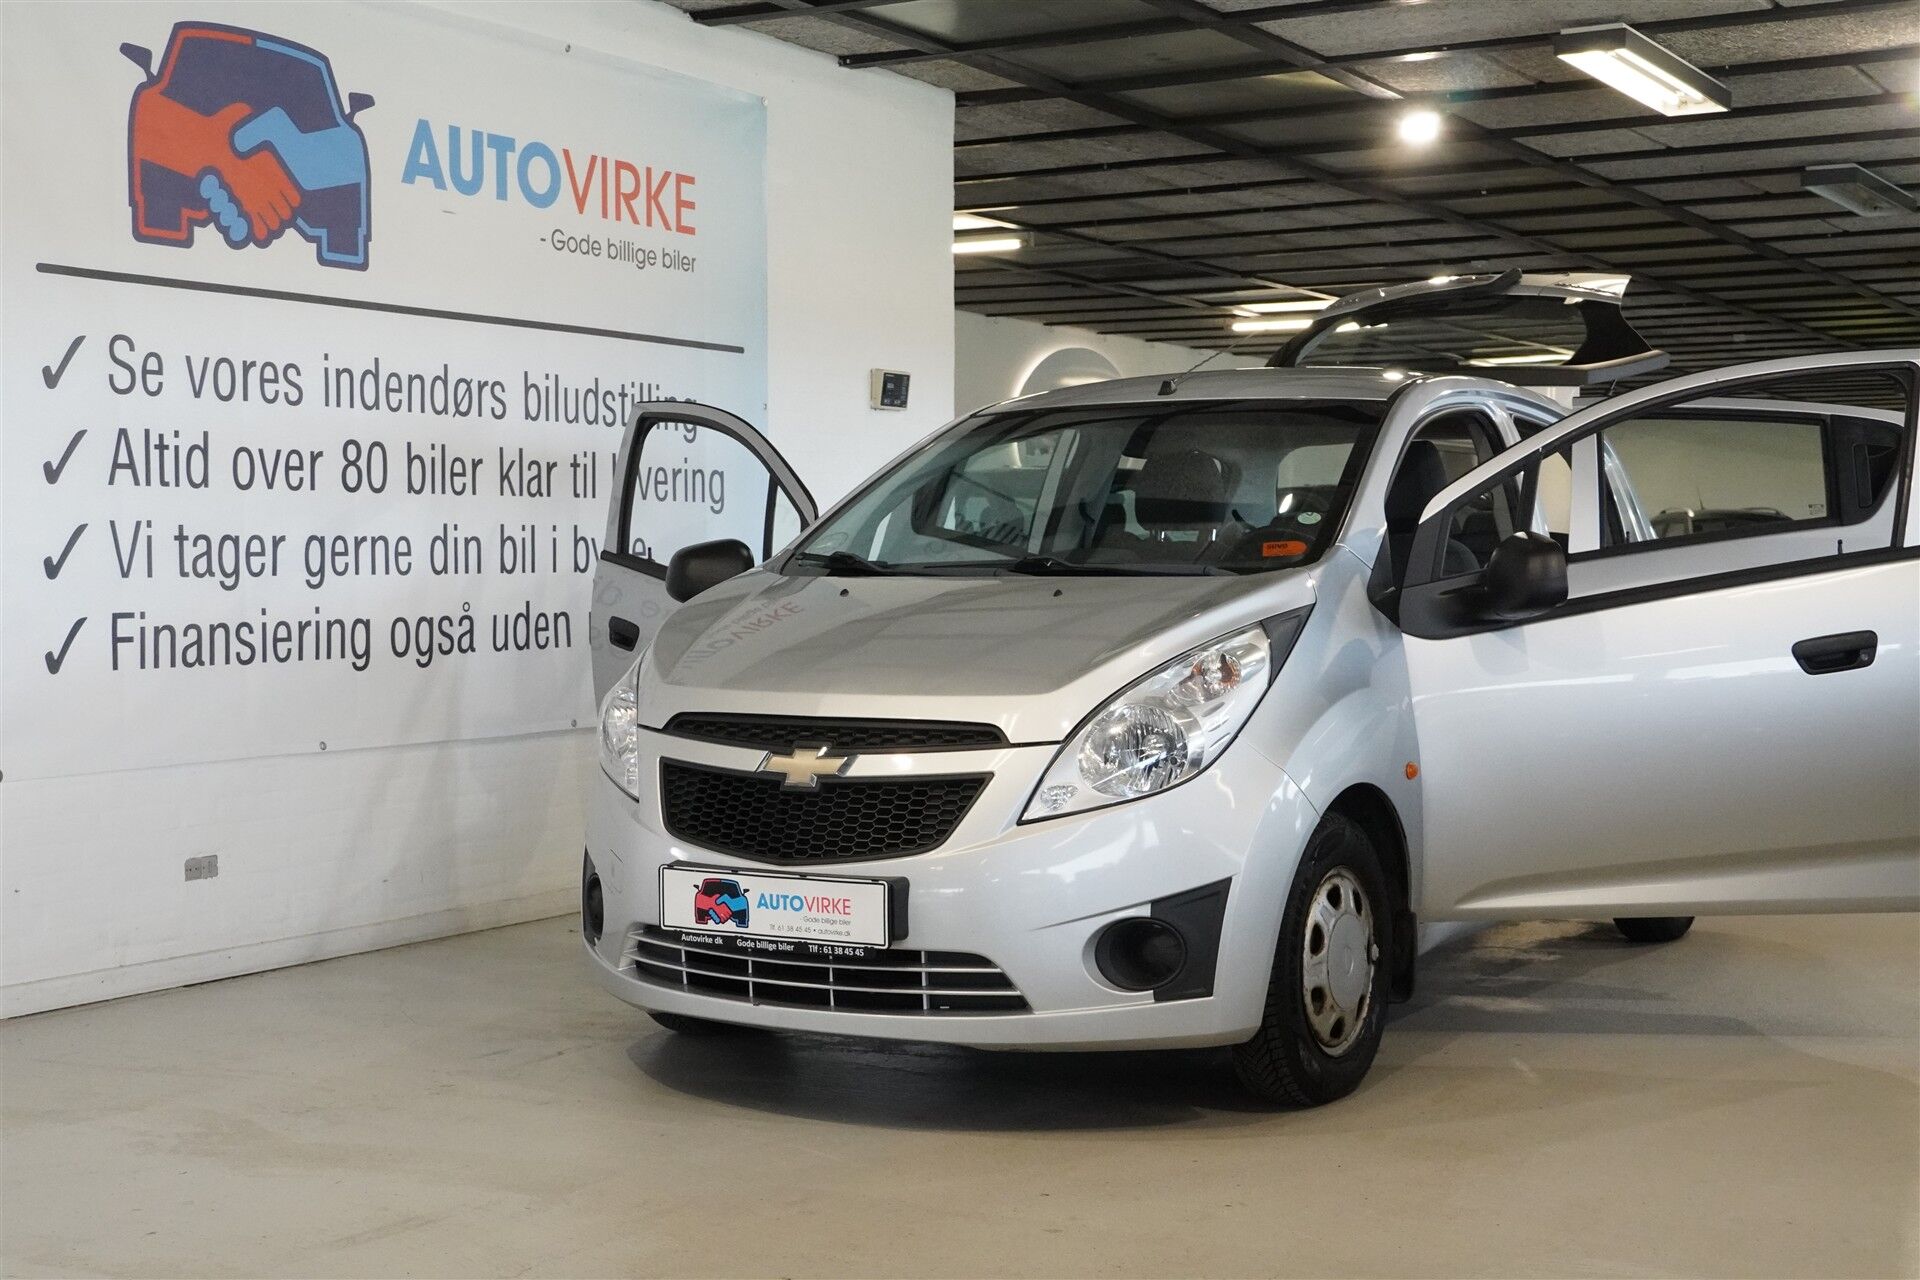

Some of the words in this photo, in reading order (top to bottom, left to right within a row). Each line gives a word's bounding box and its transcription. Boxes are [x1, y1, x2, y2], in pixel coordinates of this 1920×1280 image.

[401, 118, 696, 236] AUTOVIRKE
[551, 229, 601, 257] Gode
[607, 238, 657, 270] billige
[662, 248, 696, 273] biler
[108, 334, 164, 397] Se
[185, 355, 304, 406] vores
[324, 353, 507, 420] indendørs
[108, 428, 209, 489] Altid
[232, 446, 324, 492] over
[341, 439, 388, 494] 80
[406, 442, 484, 497] biler
[500, 447, 558, 498] klar
[570, 451, 596, 499] til
[612, 453, 725, 515] lvering
[110, 519, 153, 579] Vi
[174, 525, 286, 592] tager
[305, 535, 412, 590] gerne
[430, 524, 482, 576] din
[500, 524, 536, 575] bil
[552, 525, 557, 573] i
[111, 606, 371, 671] Finansiering
[390, 602, 477, 669] også
[493, 601, 572, 652] uden
[757, 893, 852, 916] AUTOVIRKE
[681, 933, 713, 944] Autovirke
[714, 936, 723, 945] dk
[736, 938, 755, 948] Gode
[756, 940, 776, 952] billige
[778, 942, 794, 952] biler
[808, 944, 818, 953] Tlf
[823, 945, 832, 954] 61
[834, 946, 843, 955] 38
[844, 947, 853, 956] 45
[854, 948, 864, 957] 45
